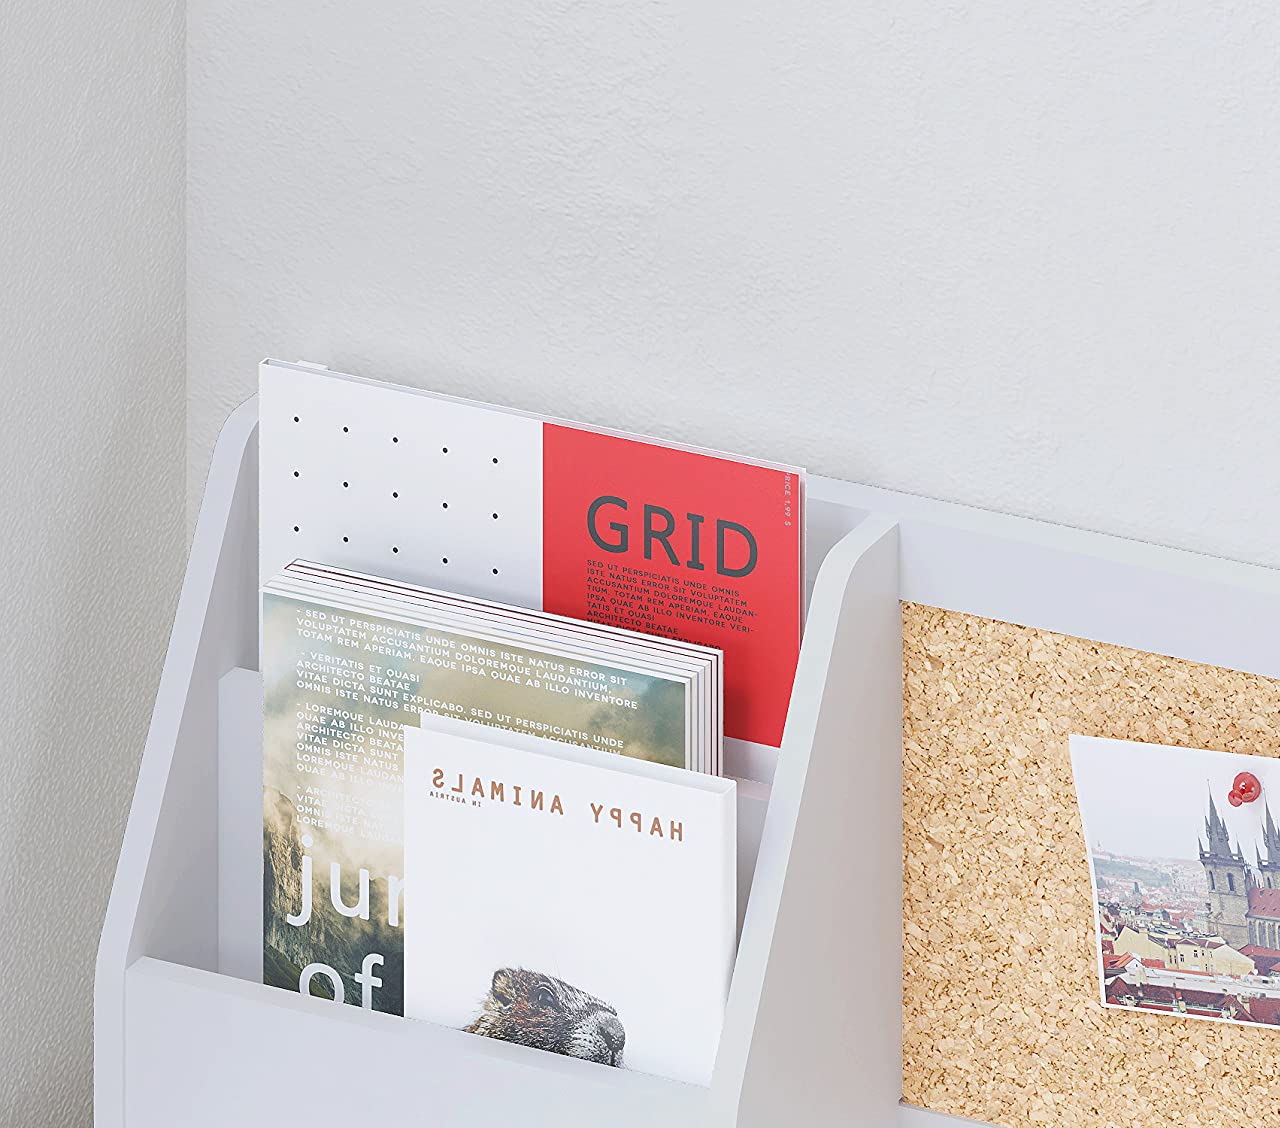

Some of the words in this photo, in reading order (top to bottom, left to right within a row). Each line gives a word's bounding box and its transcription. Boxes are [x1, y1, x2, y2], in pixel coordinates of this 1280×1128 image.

[587, 495, 758, 578] GRID
[587, 559, 603, 568] SED
[607, 563, 618, 571] UT
[622, 566, 679, 584] PERSPICIATIS
[683, 579, 707, 590] UNDE
[711, 585, 739, 597] OMNIS
[587, 567, 604, 577] ISTE
[609, 572, 637, 584] NATUS
[641, 579, 669, 591] ERROR
[673, 586, 684, 594] SIT
[690, 589, 747, 607] VOLUPTATEM
[587, 576, 650, 595] ACCUSANTIUM
[653, 590, 713, 608] DOLOREMQUE
[587, 592, 606, 602] IPSA
[610, 597, 633, 608] QUAE
[637, 603, 649, 612] AB
[653, 606, 672, 616] ILLO
[675, 611, 725, 628] INVENTORE
[587, 601, 610, 611] TATIS
[613, 606, 623, 614] ET
[627, 609, 654, 621] QUASI
[587, 609, 641, 627] ARCHITECTO
[645, 621, 678, 634] BEATAE
[614, 590, 642, 602] TOTAM
[647, 597, 664, 606] REM
[713, 611, 742, 623] EAQUE
[296, 617, 367, 641] VOLUPTATEM
[371, 633, 450, 659] ACCUSANTIUM
[455, 651, 531, 676] DOLOREMQUE
[305, 609, 326, 622] SED
[331, 614, 346, 626] UT
[349, 618, 421, 642] PERSPICIATIS
[425, 634, 456, 650] UNDE
[460, 642, 496, 658] OMNIS
[500, 650, 524, 664] ISTE
[528, 656, 564, 672] NATUS
[569, 665, 605, 681] ERROR
[610, 674, 627, 686] SIT
[296, 628, 332, 644] TOTAM
[337, 636, 359, 650] REM
[419, 654, 456, 671] EAQUE
[461, 663, 486, 677] IPSA
[490, 669, 521, 684] QUAE
[525, 676, 540, 688] AB
[545, 680, 569, 694] ILLO
[574, 687, 638, 709] INVENTORE
[296, 659, 365, 681] ARCHITECTO
[369, 674, 410, 691] BEATAE
[309, 651, 364, 671] VERITATIS
[369, 664, 382, 675] ET
[386, 667, 420, 683] QUASI
[296, 679, 331, 695] OMNIS
[335, 688, 359, 701] ISTE
[362, 693, 399, 710] NATUS
[296, 669, 327, 685] VITAE
[332, 677, 365, 693] DICTA
[369, 685, 398, 700] SUNT
[470, 706, 492, 720] SED
[496, 712, 511, 724] UT
[515, 716, 588, 740] PERSPICIATIS
[593, 732, 624, 748] UNDE
[296, 711, 325, 725] QUAE
[330, 718, 345, 729] AB
[350, 722, 373, 735] ILLO
[305, 702, 363, 723] LOREMQUE
[296, 721, 364, 743] ARCHITECTO
[296, 731, 327, 745] VITAE
[332, 739, 365, 753] DICTA
[369, 747, 398, 760] SUNT
[296, 741, 331, 757] OMNIS
[335, 750, 358, 762] ISTE
[363, 756, 399, 771] NATUS
[296, 752, 354, 773] LOREMQUE
